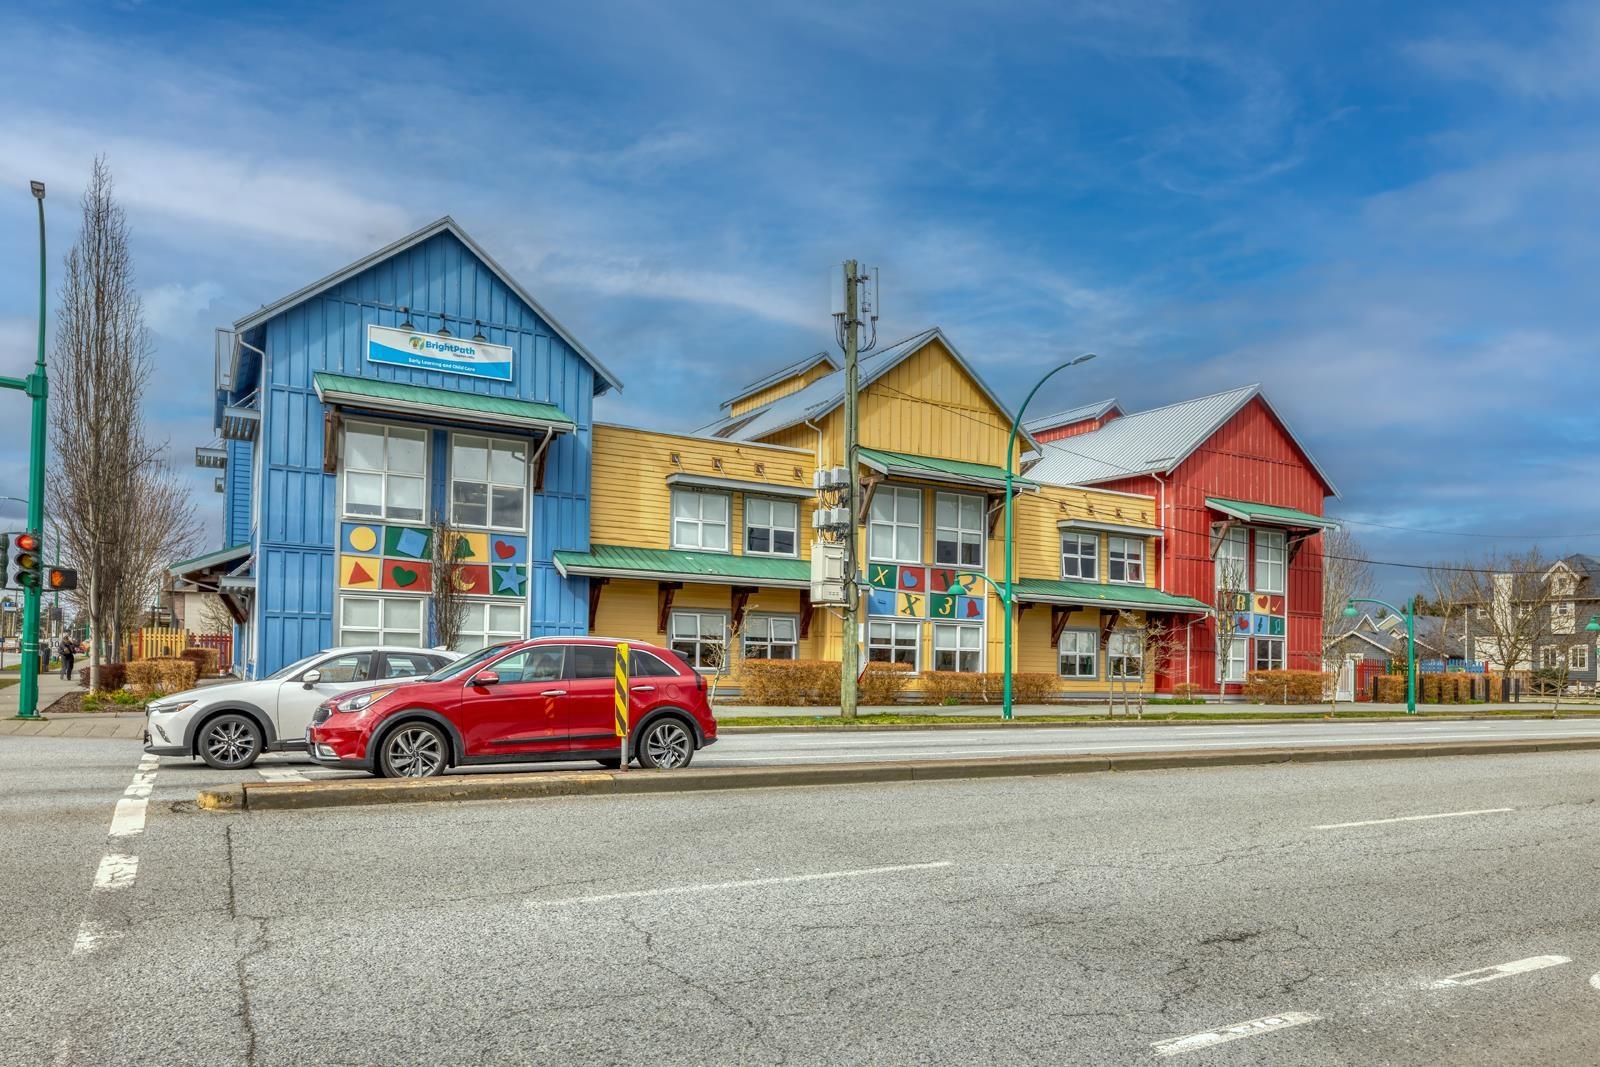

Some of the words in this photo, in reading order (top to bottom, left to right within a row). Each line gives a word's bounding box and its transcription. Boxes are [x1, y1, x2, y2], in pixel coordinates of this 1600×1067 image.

[425, 340, 475, 355] BrightPath
[408, 357, 421, 365] Early
[421, 359, 442, 368] Learning
[938, 597, 953, 615] 3
